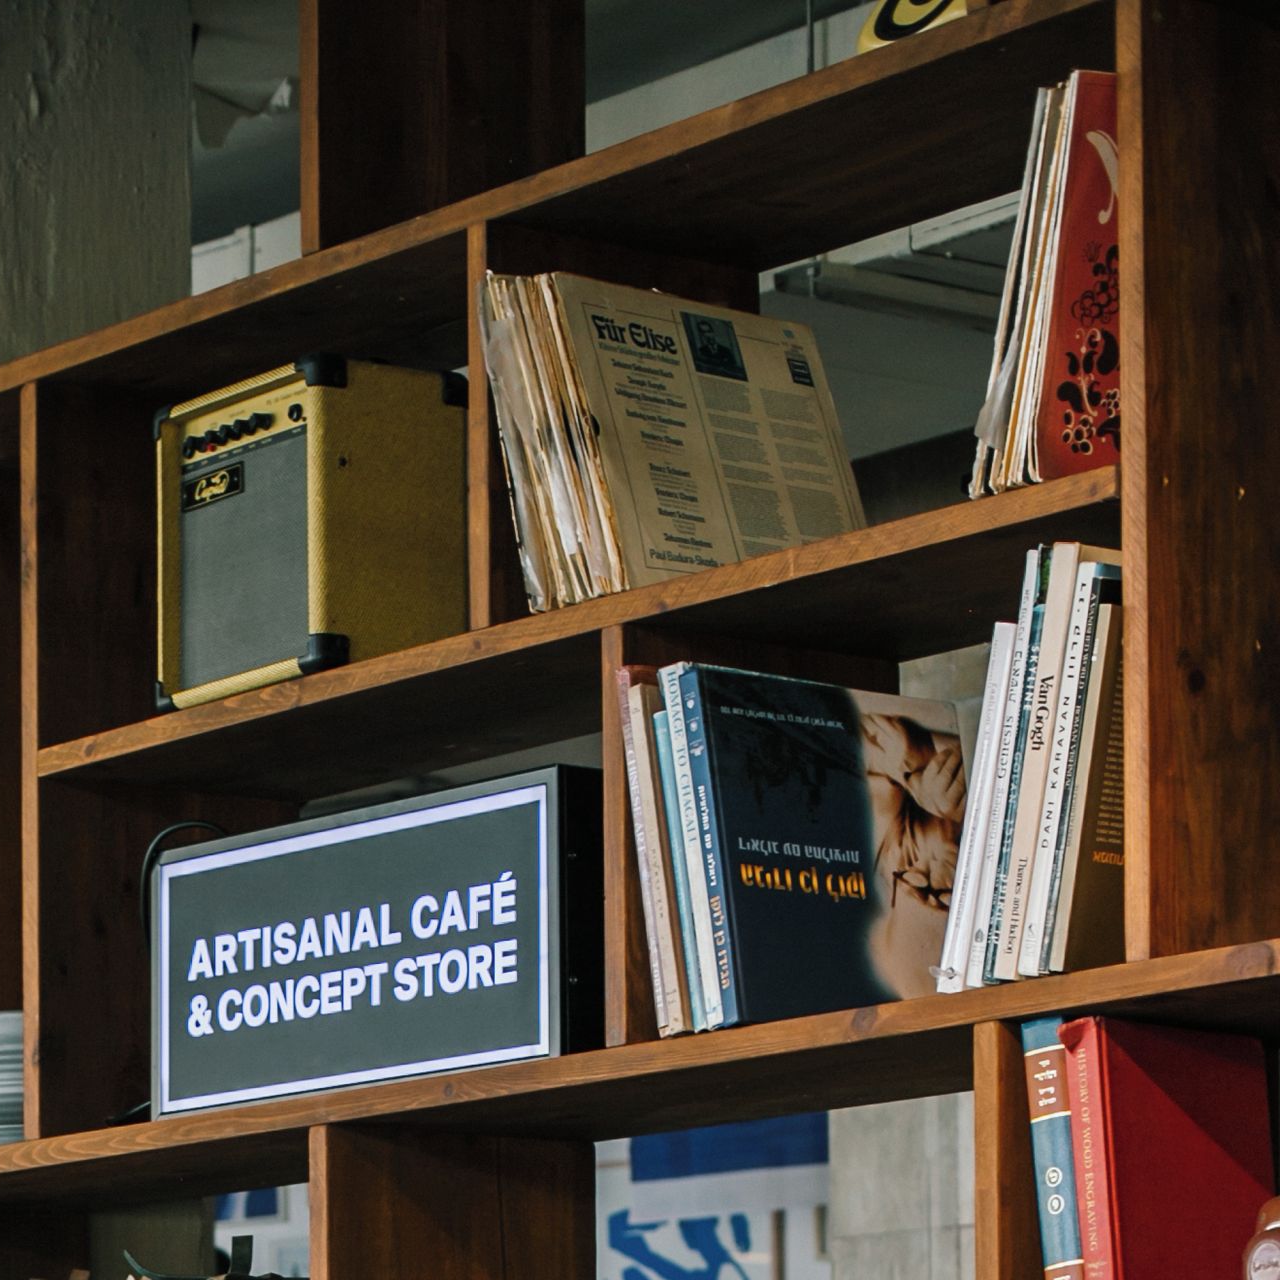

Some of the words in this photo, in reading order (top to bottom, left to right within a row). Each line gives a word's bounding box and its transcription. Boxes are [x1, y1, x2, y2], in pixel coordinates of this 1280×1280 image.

[592, 314, 626, 343] Für
[629, 323, 677, 354] Elise
[1023, 644, 1037, 711] SKYLINE
[665, 670, 683, 738] HOMAGE
[675, 744, 686, 766] TO
[997, 714, 1012, 780] Genesis
[1042, 800, 1053, 849] DANI
[1050, 695, 1069, 789] KARAVAN
[680, 773, 698, 846] CHAGALL
[738, 837, 778, 856] דיאלוג
[783, 842, 800, 857] עם
[740, 863, 792, 892] הגידו
[799, 866, 819, 895] כן
[827, 871, 866, 899] לזקן
[1015, 855, 1026, 895] Thames
[188, 903, 401, 983] ARTISANAL
[410, 871, 517, 934] CAFÉ
[1012, 897, 1022, 916] and
[1005, 917, 1018, 955] Hudson
[187, 994, 215, 1037] &
[217, 964, 391, 1034] CONCEPT
[392, 939, 518, 1002] STORE
[1080, 1048, 1089, 1103] HISTORY
[1081, 1105, 1091, 1125] OF
[1082, 1127, 1094, 1174] WOOD
[1085, 1179, 1099, 1251] ENGRAVING
